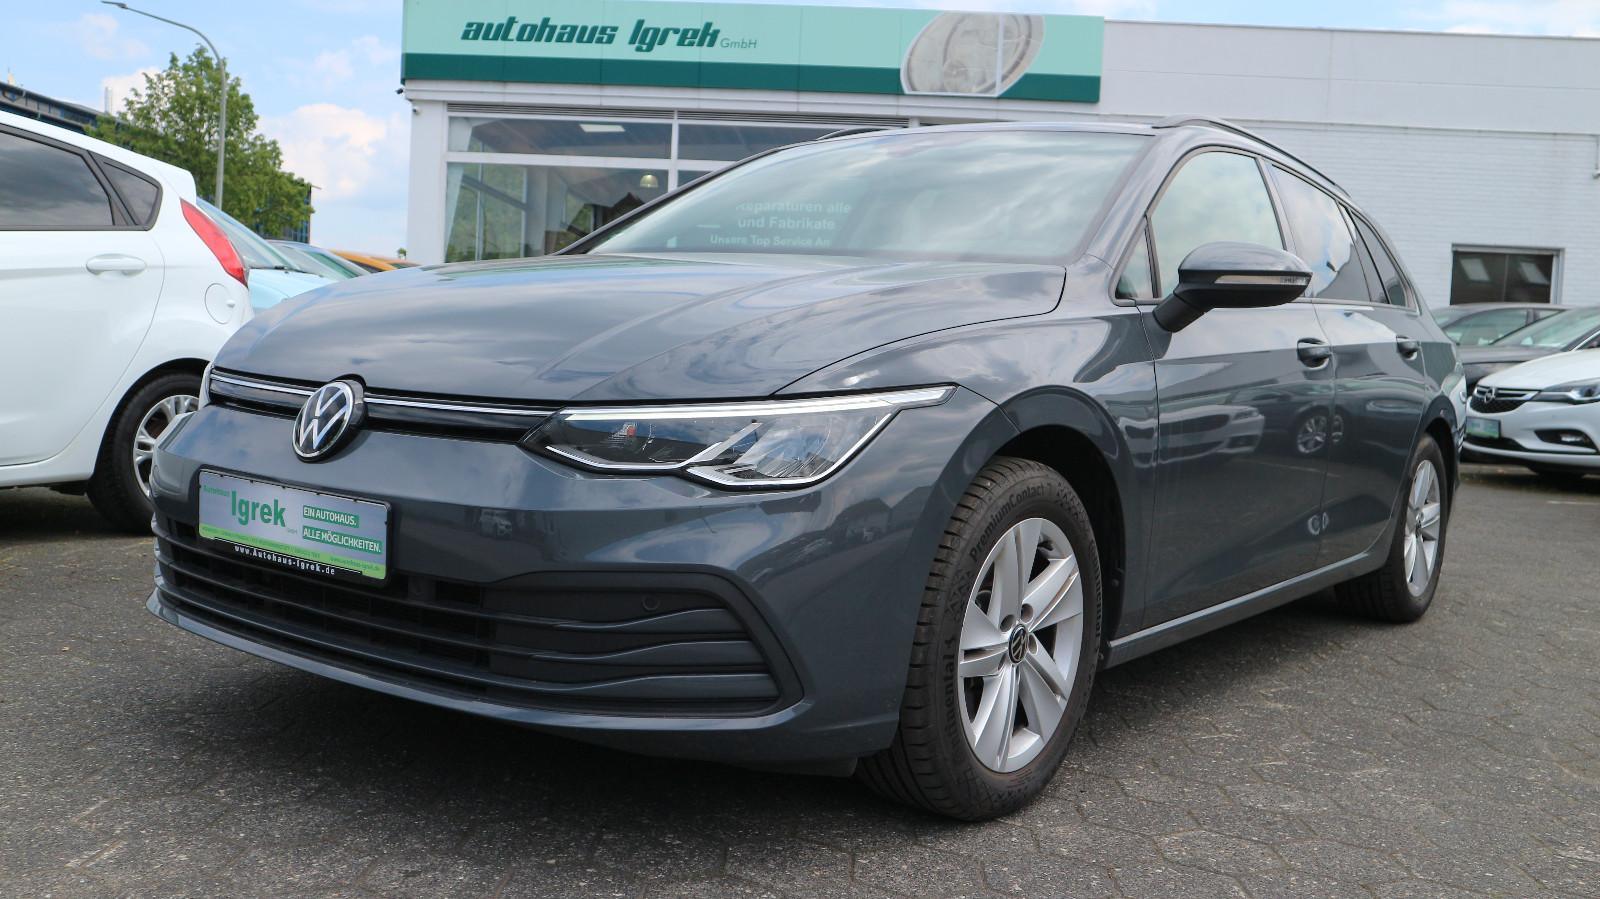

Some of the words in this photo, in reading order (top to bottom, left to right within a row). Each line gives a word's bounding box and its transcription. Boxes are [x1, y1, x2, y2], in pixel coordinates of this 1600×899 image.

[461, 16, 619, 45] autohaus
[628, 19, 720, 52] Igrek
[719, 38, 757, 49] GmbH
[737, 217, 765, 228] und
[769, 217, 835, 230] Fabrikate
[710, 234, 747, 245] Unsere
[751, 235, 770, 247] Top
[773, 236, 812, 246] Service
[231, 490, 286, 527] Igrek
[303, 508, 315, 518] EIN
[315, 510, 357, 525] AUTOHAUS.
[969, 484, 1045, 561] PremiumContact
[303, 528, 321, 540] ALLE
[321, 529, 381, 553] MÖGLICHKEITEN.
